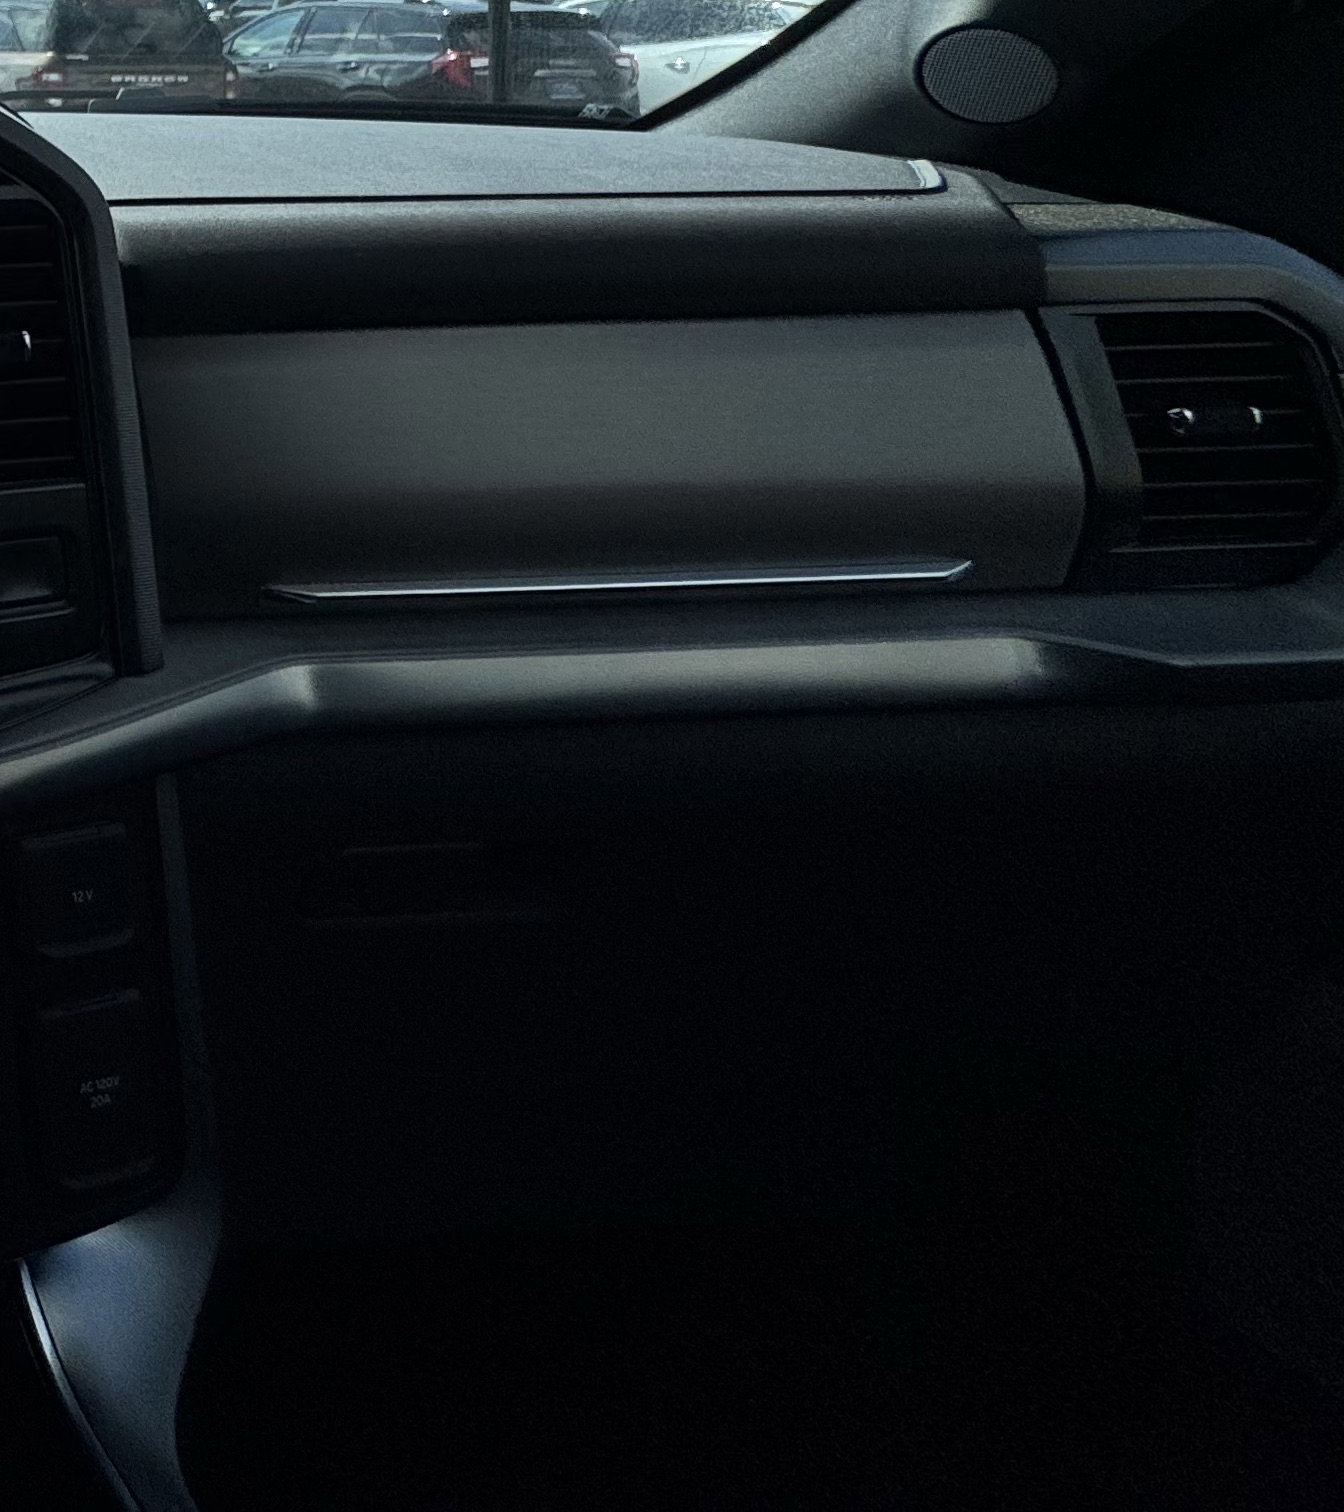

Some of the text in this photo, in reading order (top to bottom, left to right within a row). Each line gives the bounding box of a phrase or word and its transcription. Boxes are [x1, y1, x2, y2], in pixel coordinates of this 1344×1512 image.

[71, 888, 94, 903] 12V
[79, 1076, 121, 1095] AC 120V
[89, 1093, 112, 1110] 20A
